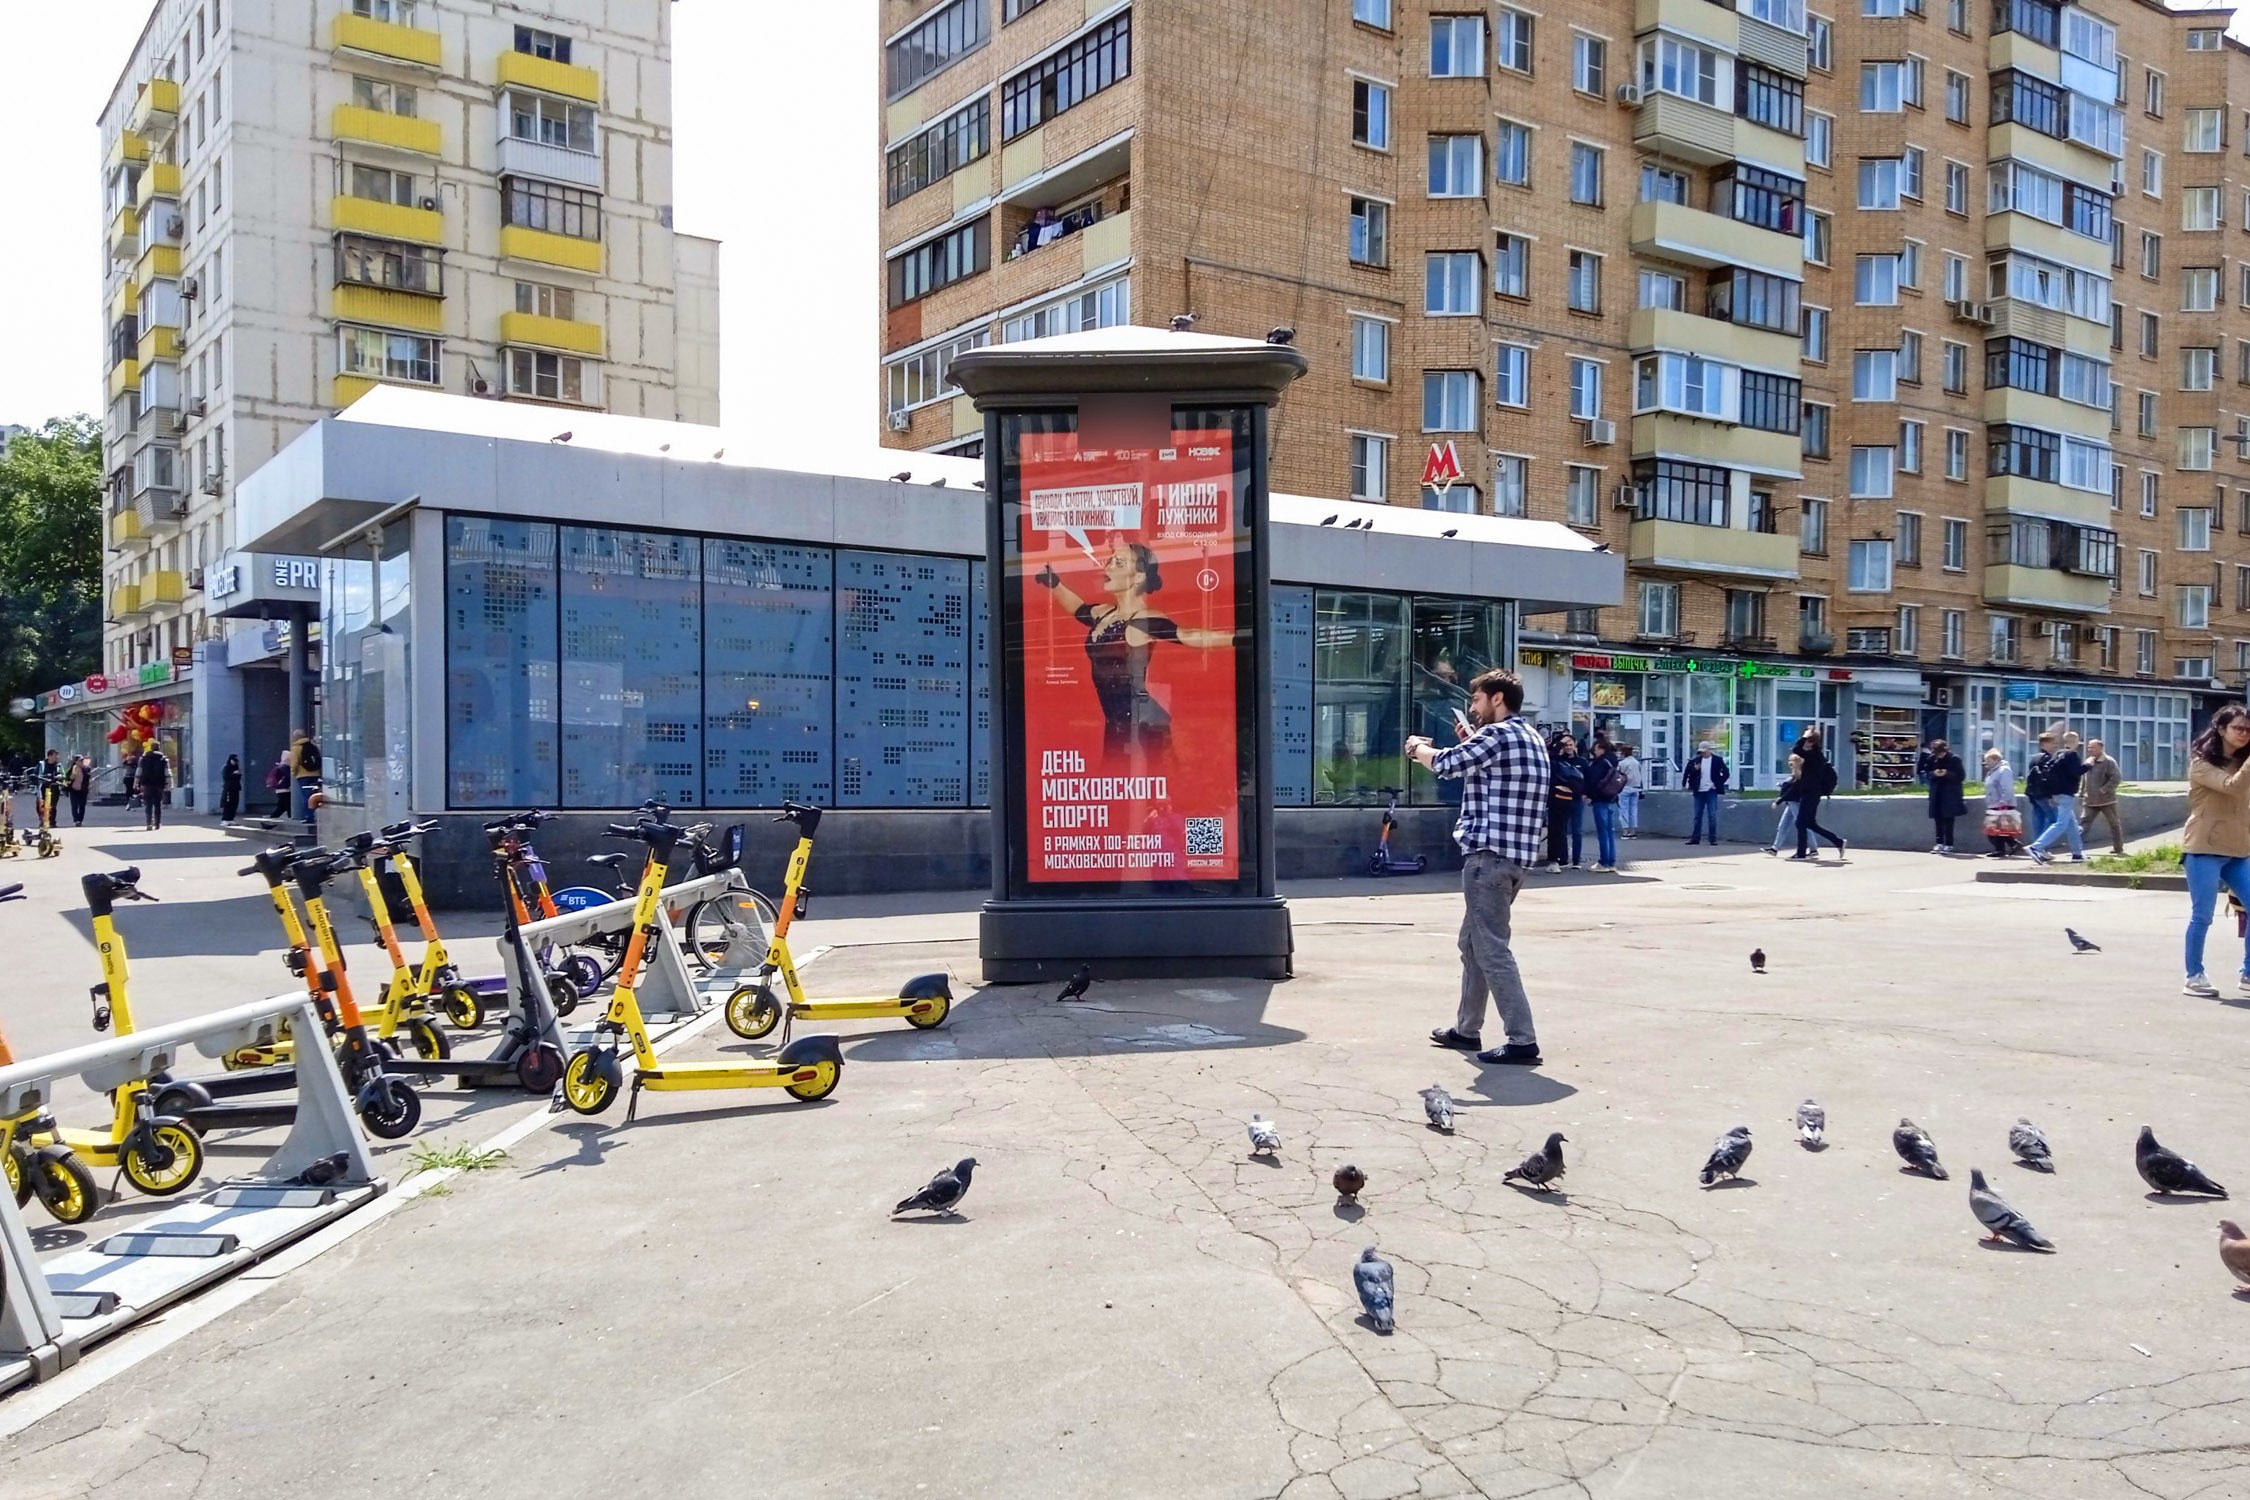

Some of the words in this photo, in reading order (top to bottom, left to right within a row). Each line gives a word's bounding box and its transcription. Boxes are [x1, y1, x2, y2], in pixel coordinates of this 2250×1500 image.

[1065, 490, 1095, 508] СМОТРИ,
[1096, 485, 1141, 508] УЧАСТВУЙ,
[1157, 484, 1163, 507] 1
[1168, 483, 1218, 506] ИЮЛЯ
[1069, 511, 1074, 526] В
[1075, 510, 1115, 526] ЛУЖНИКАХ
[1157, 507, 1218, 525] ЛУЖНИКИ
[275, 560, 288, 587] ONE
[1203, 574, 1214, 586] 0+
[1574, 655, 1610, 668] ШАУРМА
[1613, 655, 1649, 671] ВЫПЕЧКА
[1041, 750, 1085, 776] ДЕНЬ
[1042, 777, 1167, 801] МОСКОВСКОГО
[1042, 805, 1109, 828] СПОРТА
[1044, 836, 1052, 851] В
[1054, 836, 1101, 851] РАМКАХ
[1103, 834, 1162, 850] 100-ЛЕТИЯ
[1044, 853, 1126, 869] МОСКОВСКОГО
[1128, 852, 1175, 868] СПОРТА!
[568, 896, 587, 905] ВТБ
